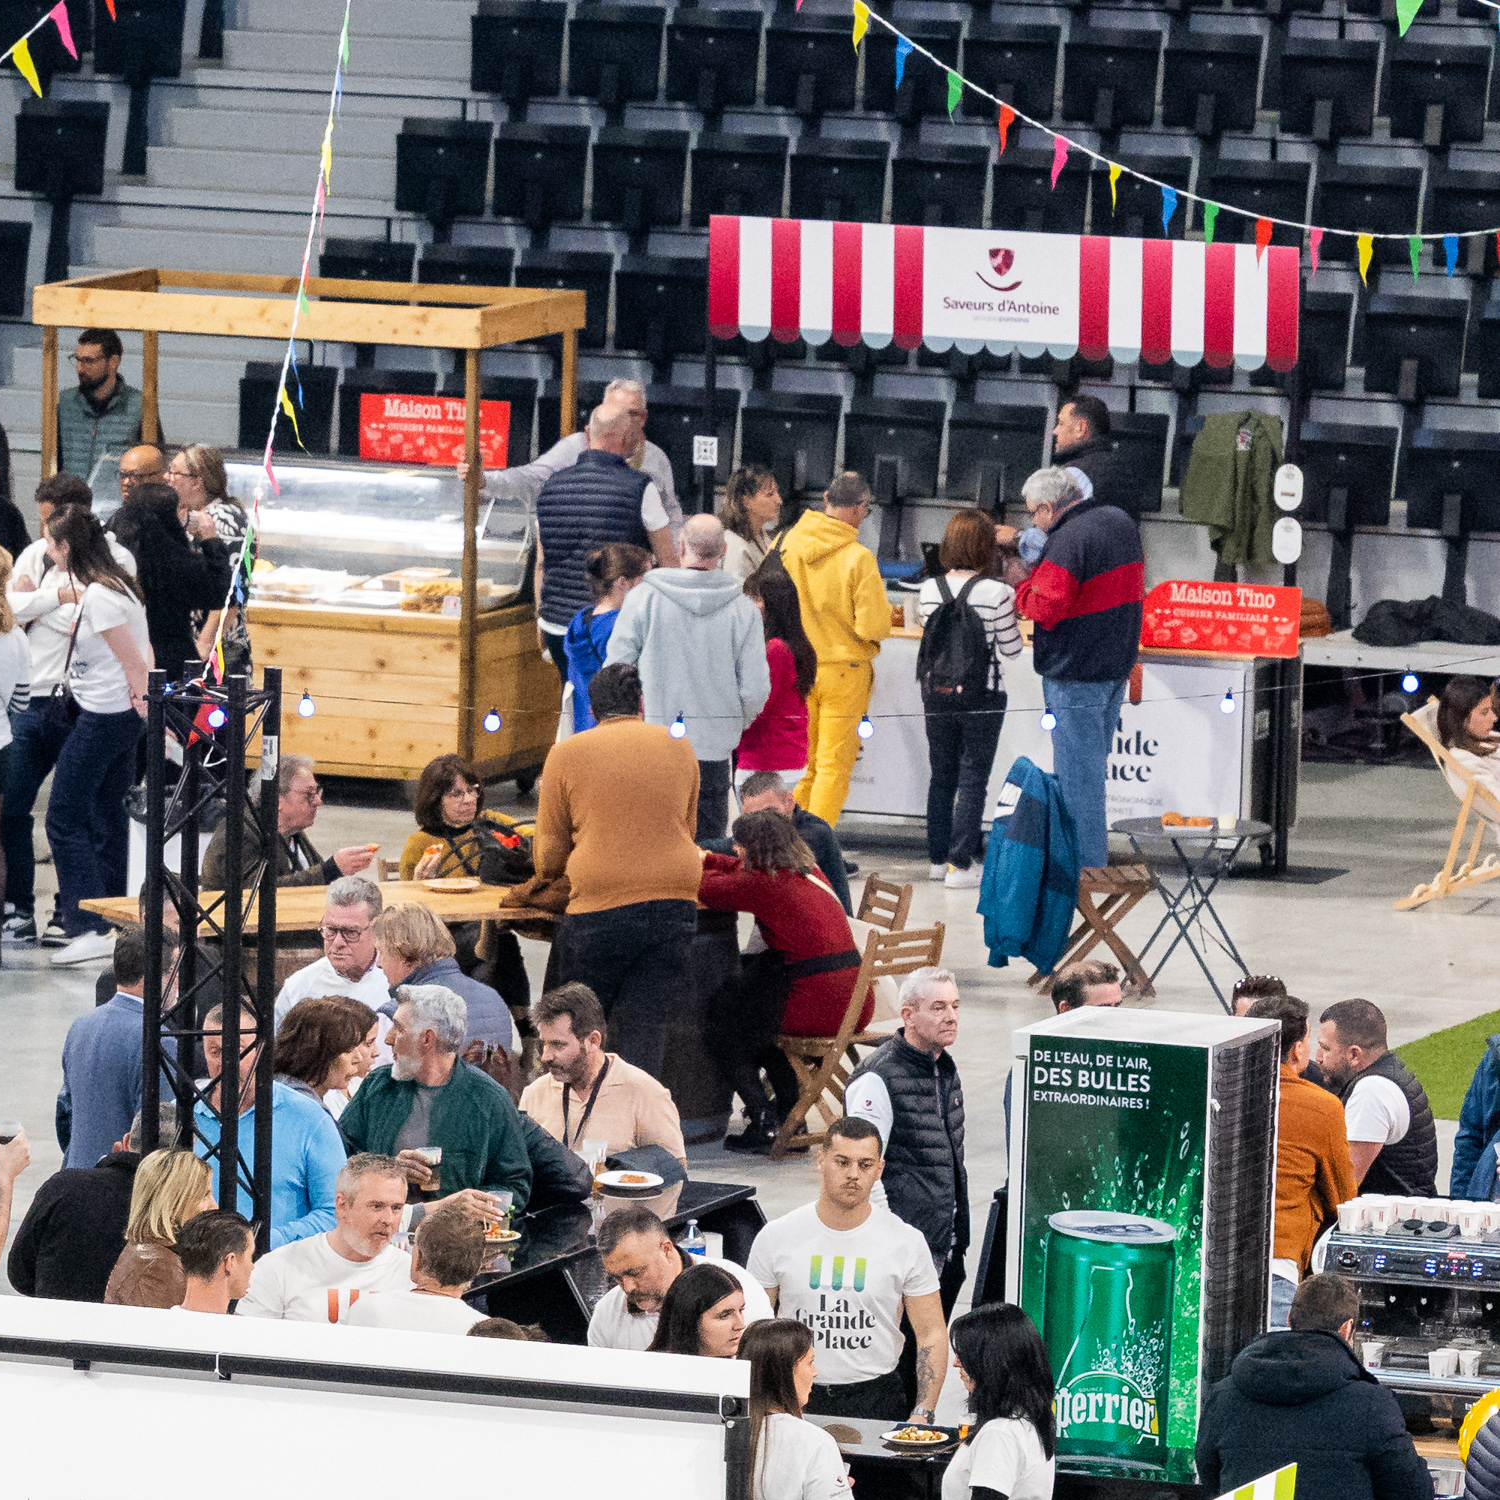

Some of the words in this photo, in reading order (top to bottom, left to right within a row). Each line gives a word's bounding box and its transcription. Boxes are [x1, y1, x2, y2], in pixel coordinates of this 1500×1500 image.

[943, 296, 994, 313] Saveurs
[998, 298, 1060, 315] d'Antoine
[384, 398, 441, 420] Maison
[1170, 583, 1232, 606] Maison
[1235, 586, 1275, 609] Tino
[1033, 1049, 1051, 1064] DE
[1054, 1051, 1094, 1068] L'EAU,
[1096, 1054, 1114, 1069] DE
[1116, 1056, 1152, 1073] L'AIR,
[1033, 1066, 1073, 1087] DES
[1077, 1069, 1151, 1093] BULLES
[1033, 1089, 1143, 1110] EXTRAORDINAIRES
[819, 1294, 849, 1313] La
